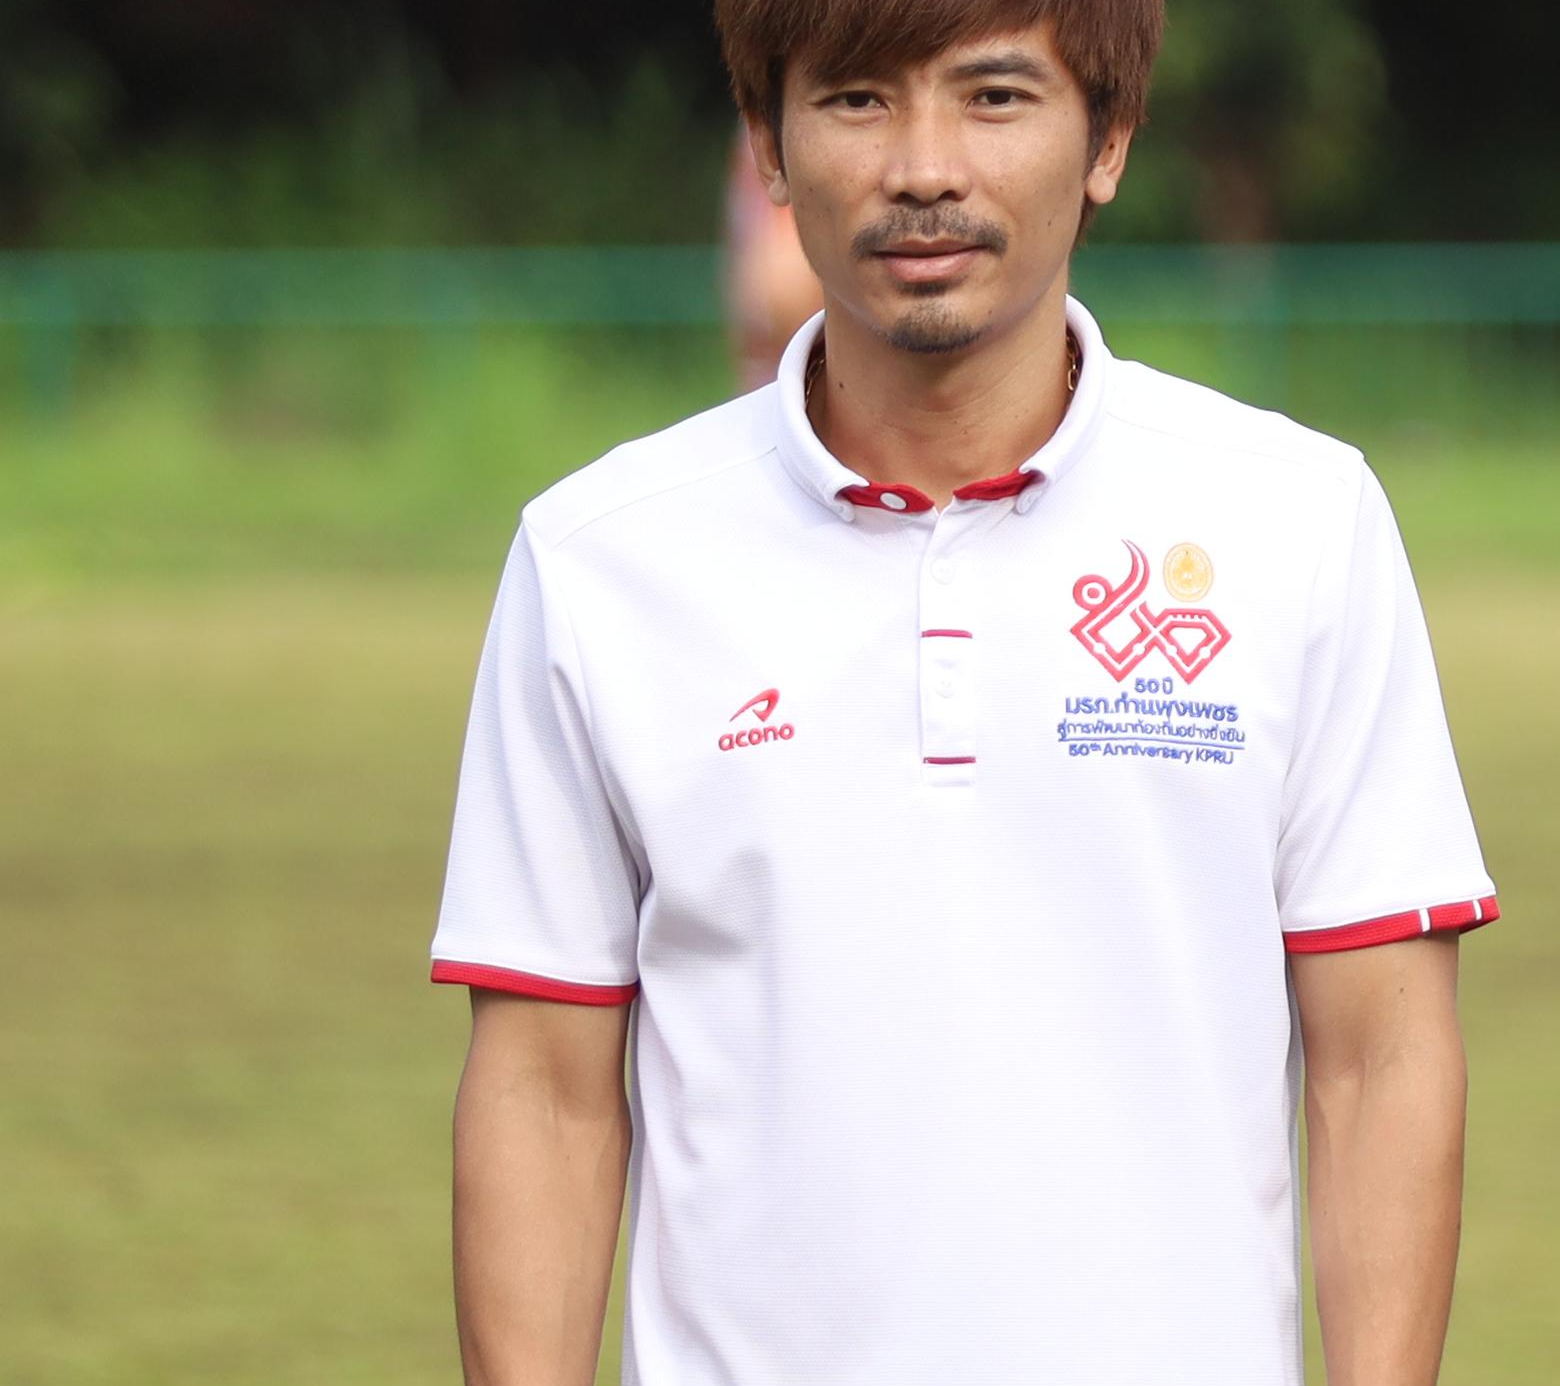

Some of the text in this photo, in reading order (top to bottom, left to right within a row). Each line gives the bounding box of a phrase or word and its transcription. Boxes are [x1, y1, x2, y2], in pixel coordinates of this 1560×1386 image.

[1134, 676, 1174, 695] 50 ปี
[718, 723, 795, 751] acono
[1068, 742, 1234, 764] 50th Anniversary KPRU
